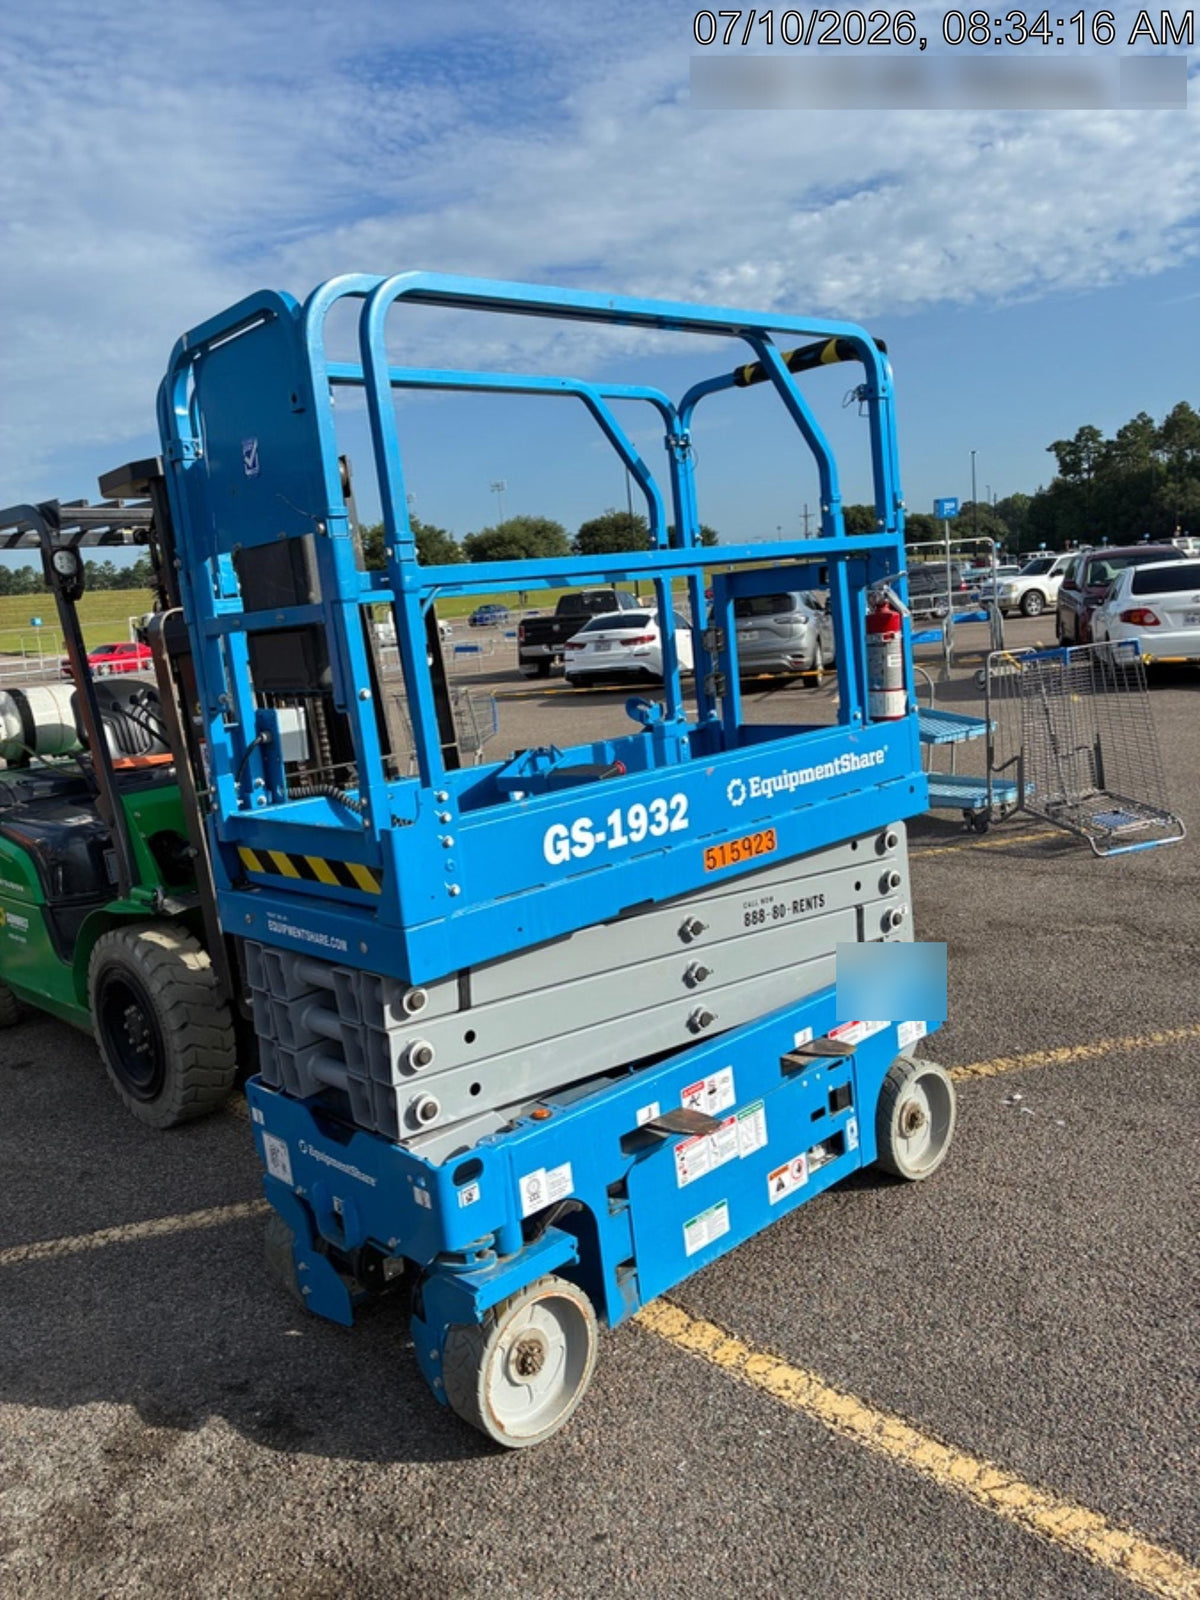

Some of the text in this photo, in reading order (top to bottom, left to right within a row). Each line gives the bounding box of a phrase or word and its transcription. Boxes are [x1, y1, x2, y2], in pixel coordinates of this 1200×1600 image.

[748, 749, 885, 798] EquipmentShare
[543, 793, 690, 865] GS-1932
[705, 829, 776, 870] 515923
[744, 893, 825, 927] 888-80-RENTS
